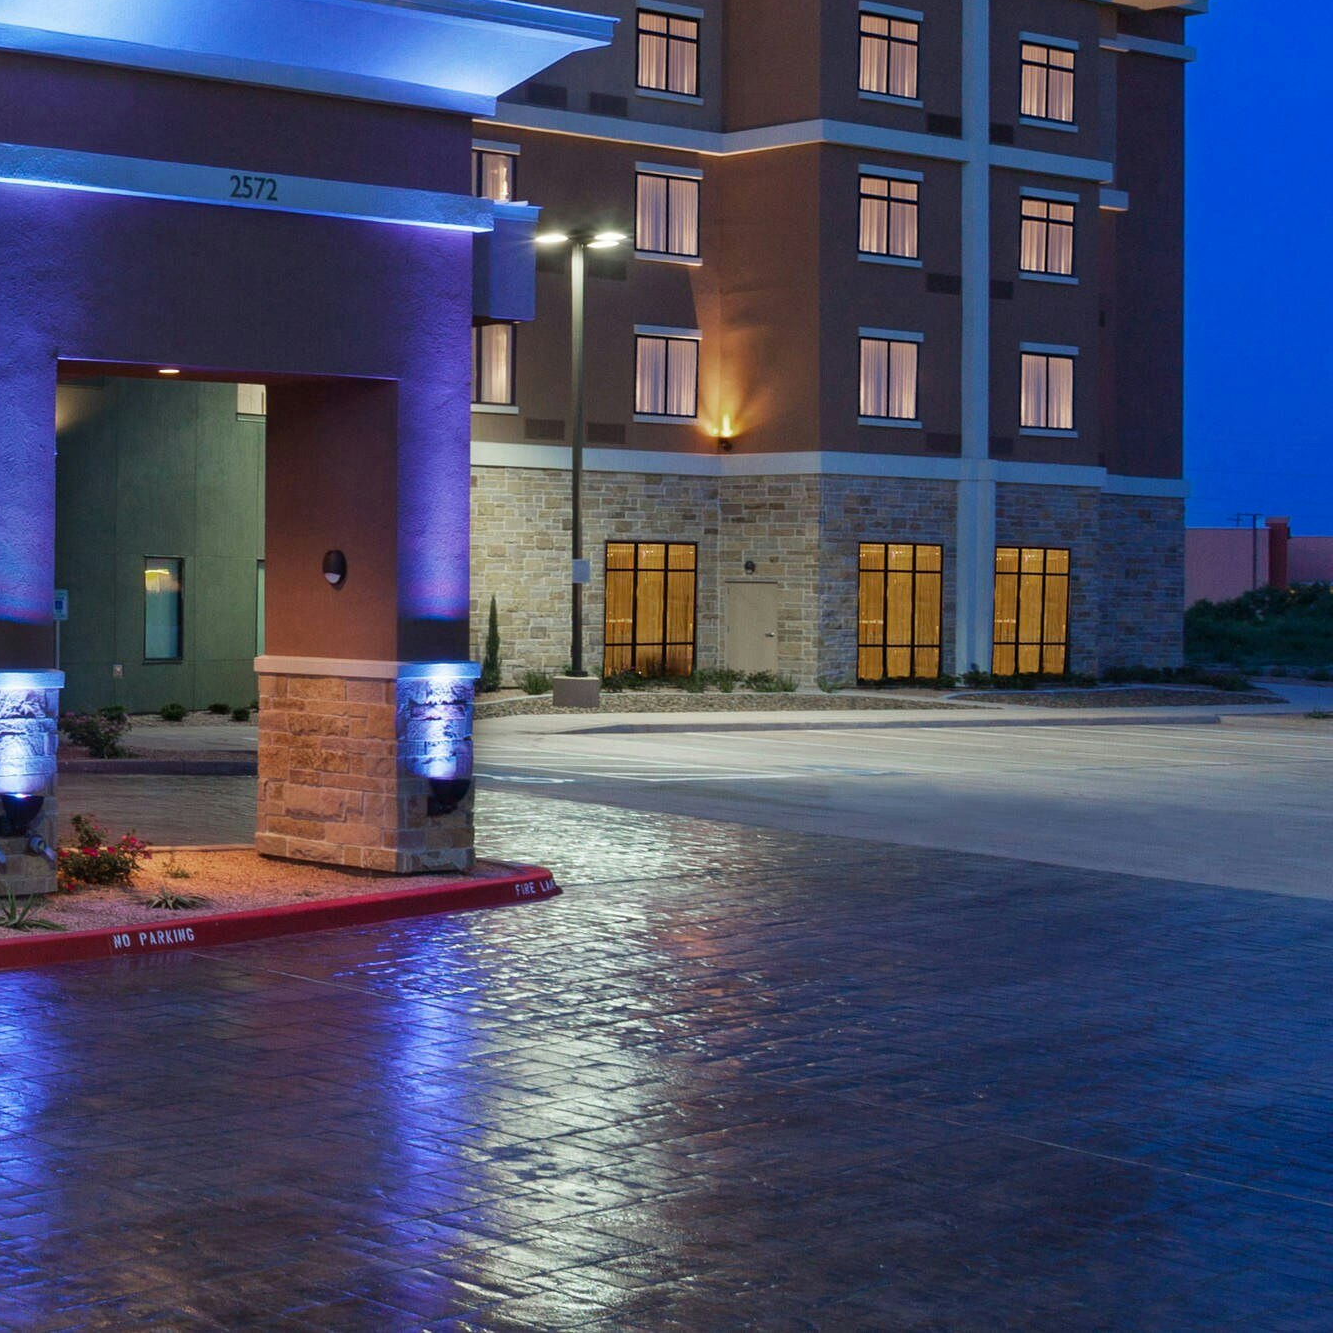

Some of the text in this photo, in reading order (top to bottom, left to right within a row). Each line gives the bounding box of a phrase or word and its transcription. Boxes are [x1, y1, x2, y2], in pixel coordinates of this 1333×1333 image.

[230, 175, 278, 201] 2572
[515, 881, 536, 897] FIRE
[113, 927, 195, 949] NO PARKING
